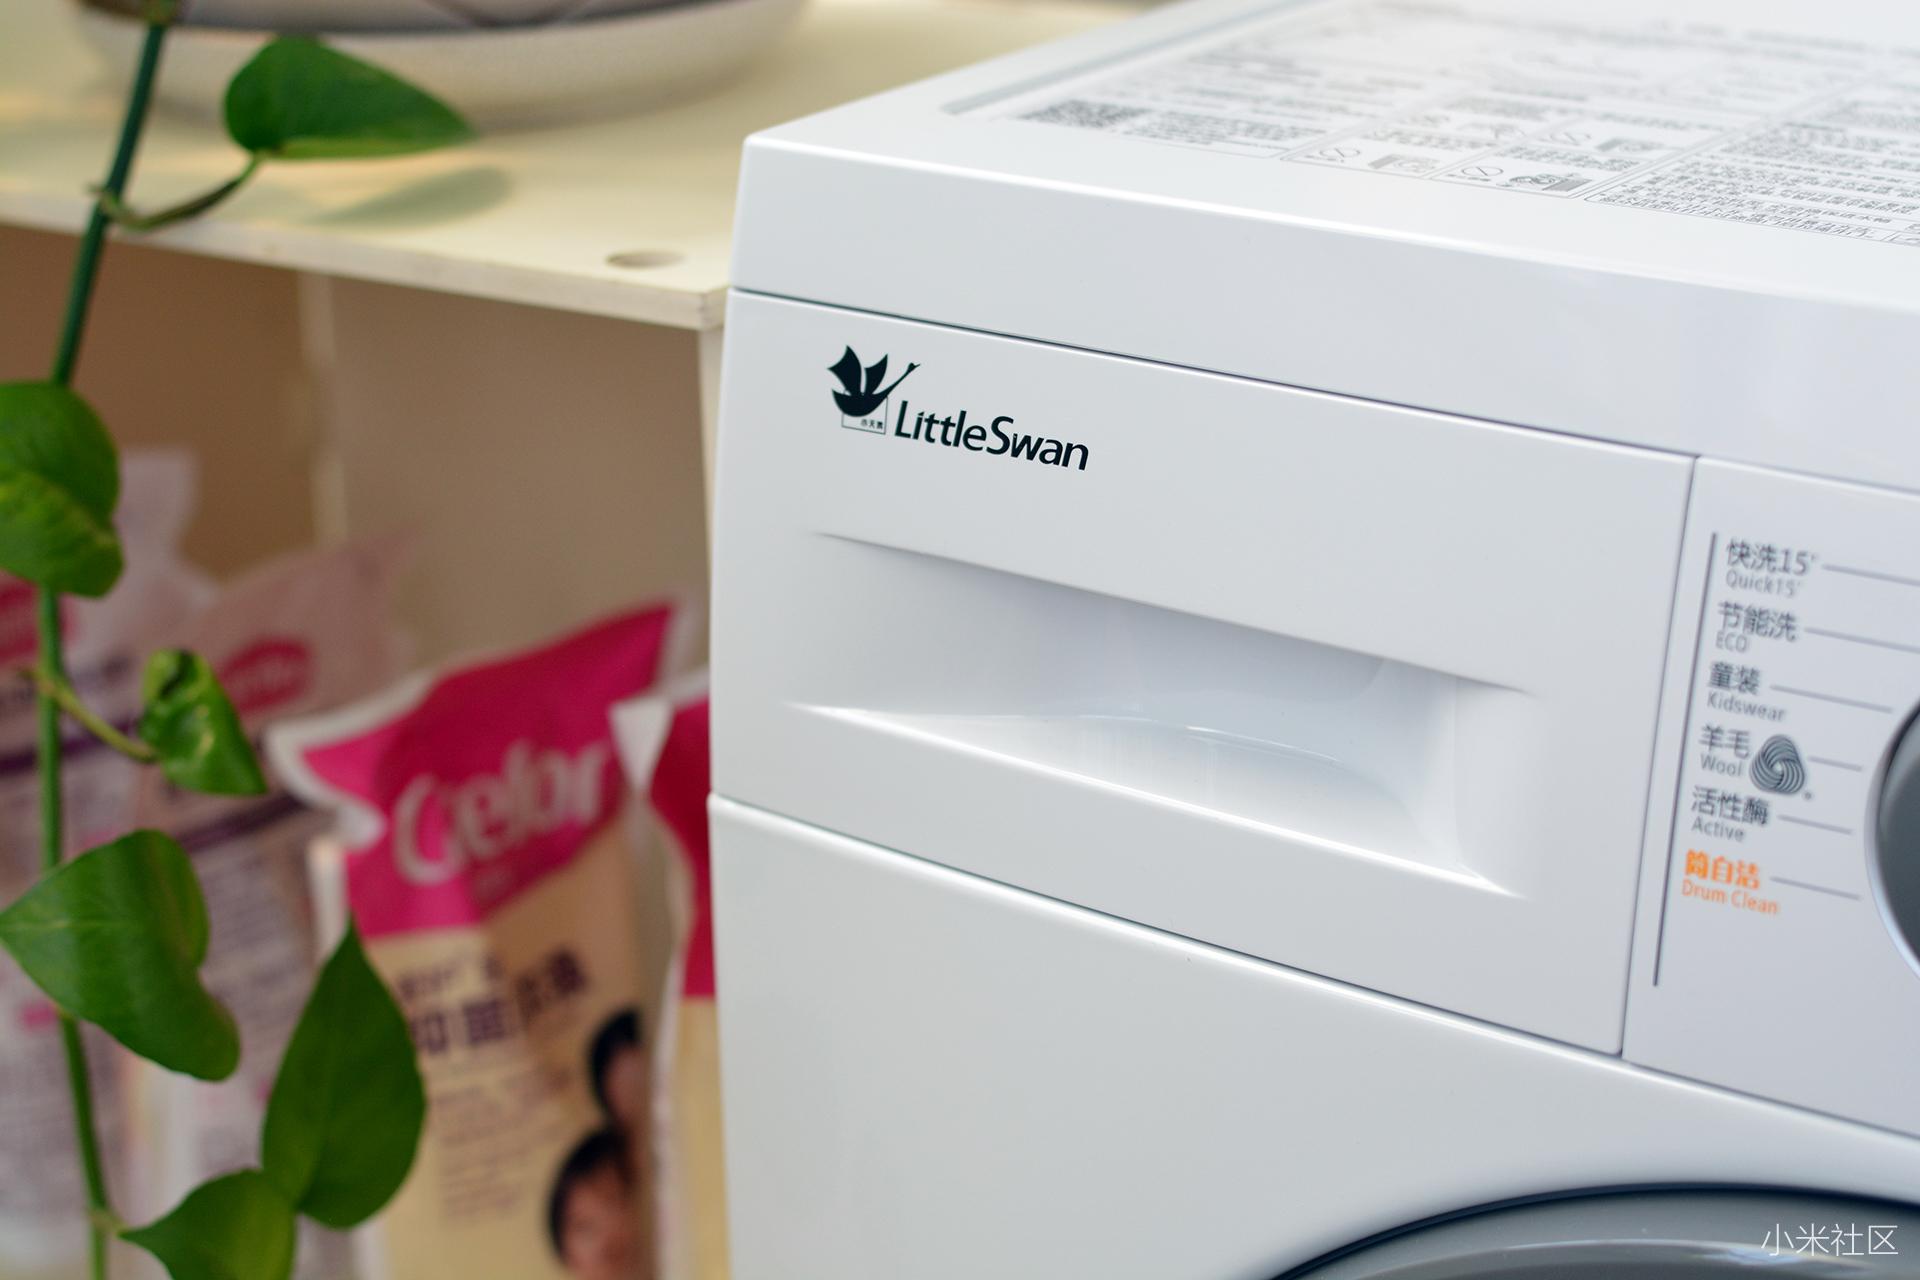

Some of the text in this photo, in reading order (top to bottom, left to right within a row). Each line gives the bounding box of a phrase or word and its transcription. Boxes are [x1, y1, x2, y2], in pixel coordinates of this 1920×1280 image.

[895, 400, 1089, 470] LittleSwan
[1717, 600, 1797, 642] 节能洗
[1715, 631, 1748, 653] ECO
[1709, 660, 1760, 695] 童装
[1707, 691, 1785, 721] Kidswear
[1699, 724, 1750, 760] 羊毛
[1700, 754, 1742, 777] Wool
[1691, 784, 1770, 827] 活性酶
[1691, 816, 1745, 842] Active
[1682, 878, 1778, 915] Drum Clean
